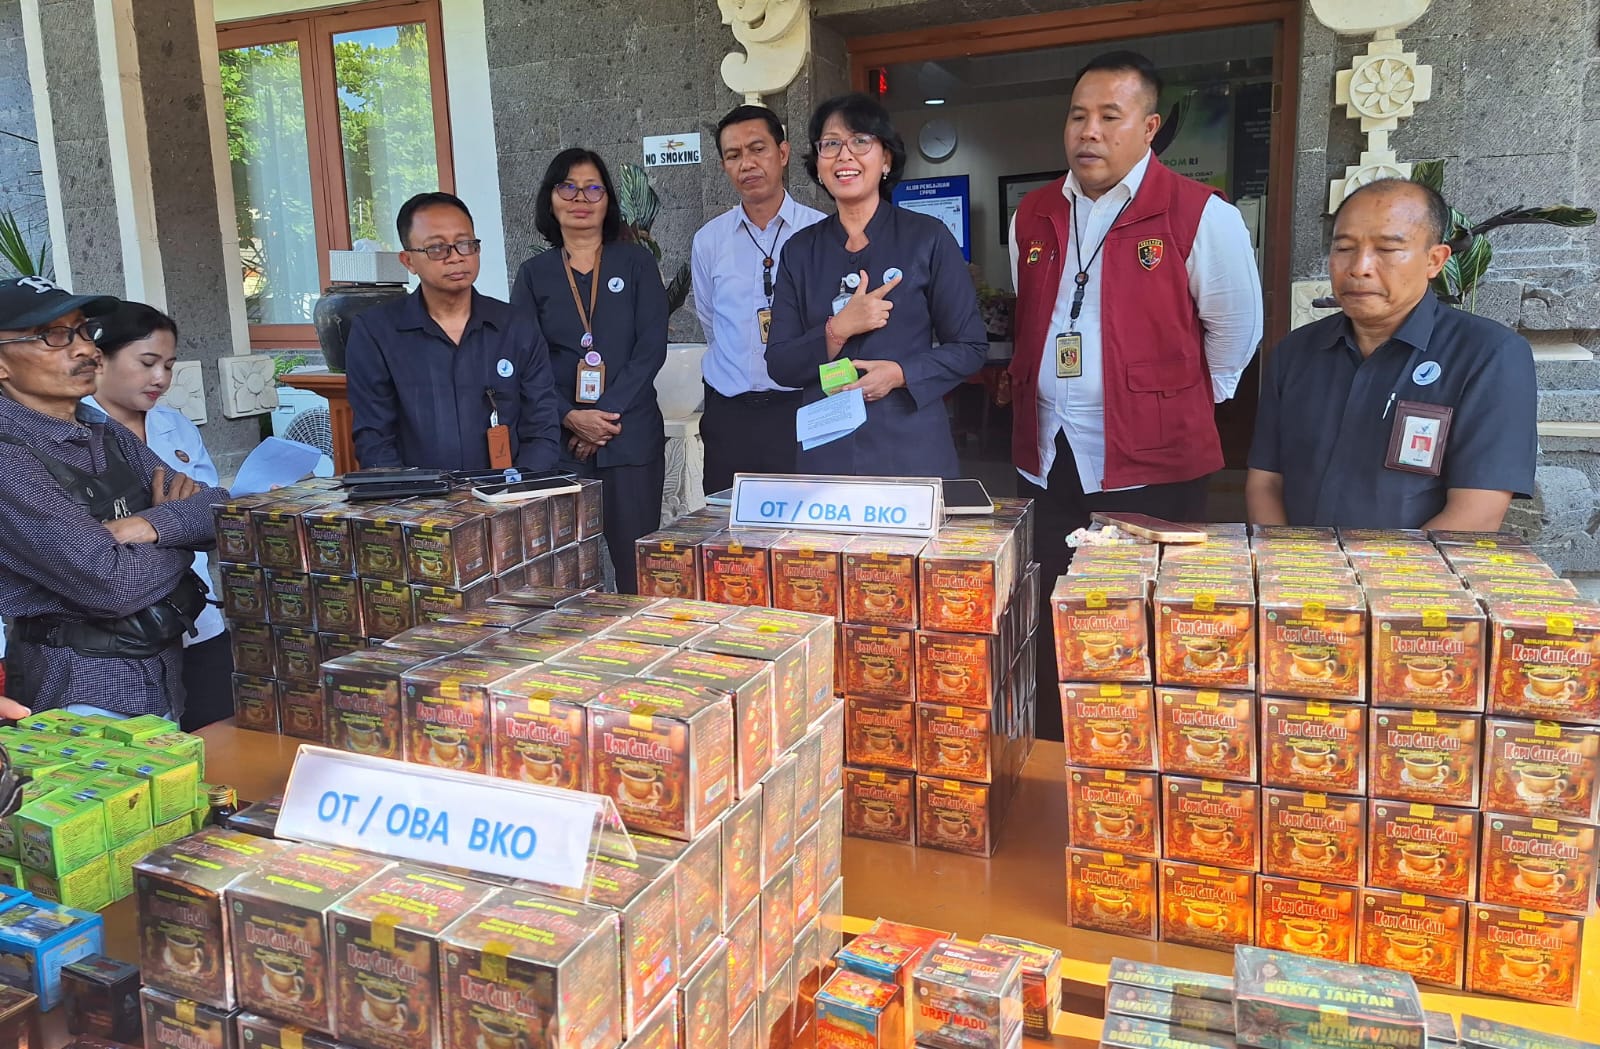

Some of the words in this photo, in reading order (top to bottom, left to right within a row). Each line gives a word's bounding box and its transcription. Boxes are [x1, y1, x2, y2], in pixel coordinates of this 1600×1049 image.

[645, 153, 656, 165] NO
[660, 150, 699, 163] SMOKING
[760, 500, 788, 518] OT
[808, 503, 851, 523] OBA
[864, 505, 907, 525] BKO
[317, 790, 359, 827] OT
[386, 803, 449, 846] OBA
[468, 817, 538, 861] BKO
[1263, 982, 1320, 999] BUAYA
[1324, 989, 1395, 1008] JANTAN
[919, 1004, 950, 1024] URAT
[952, 1013, 988, 1031] MADU
